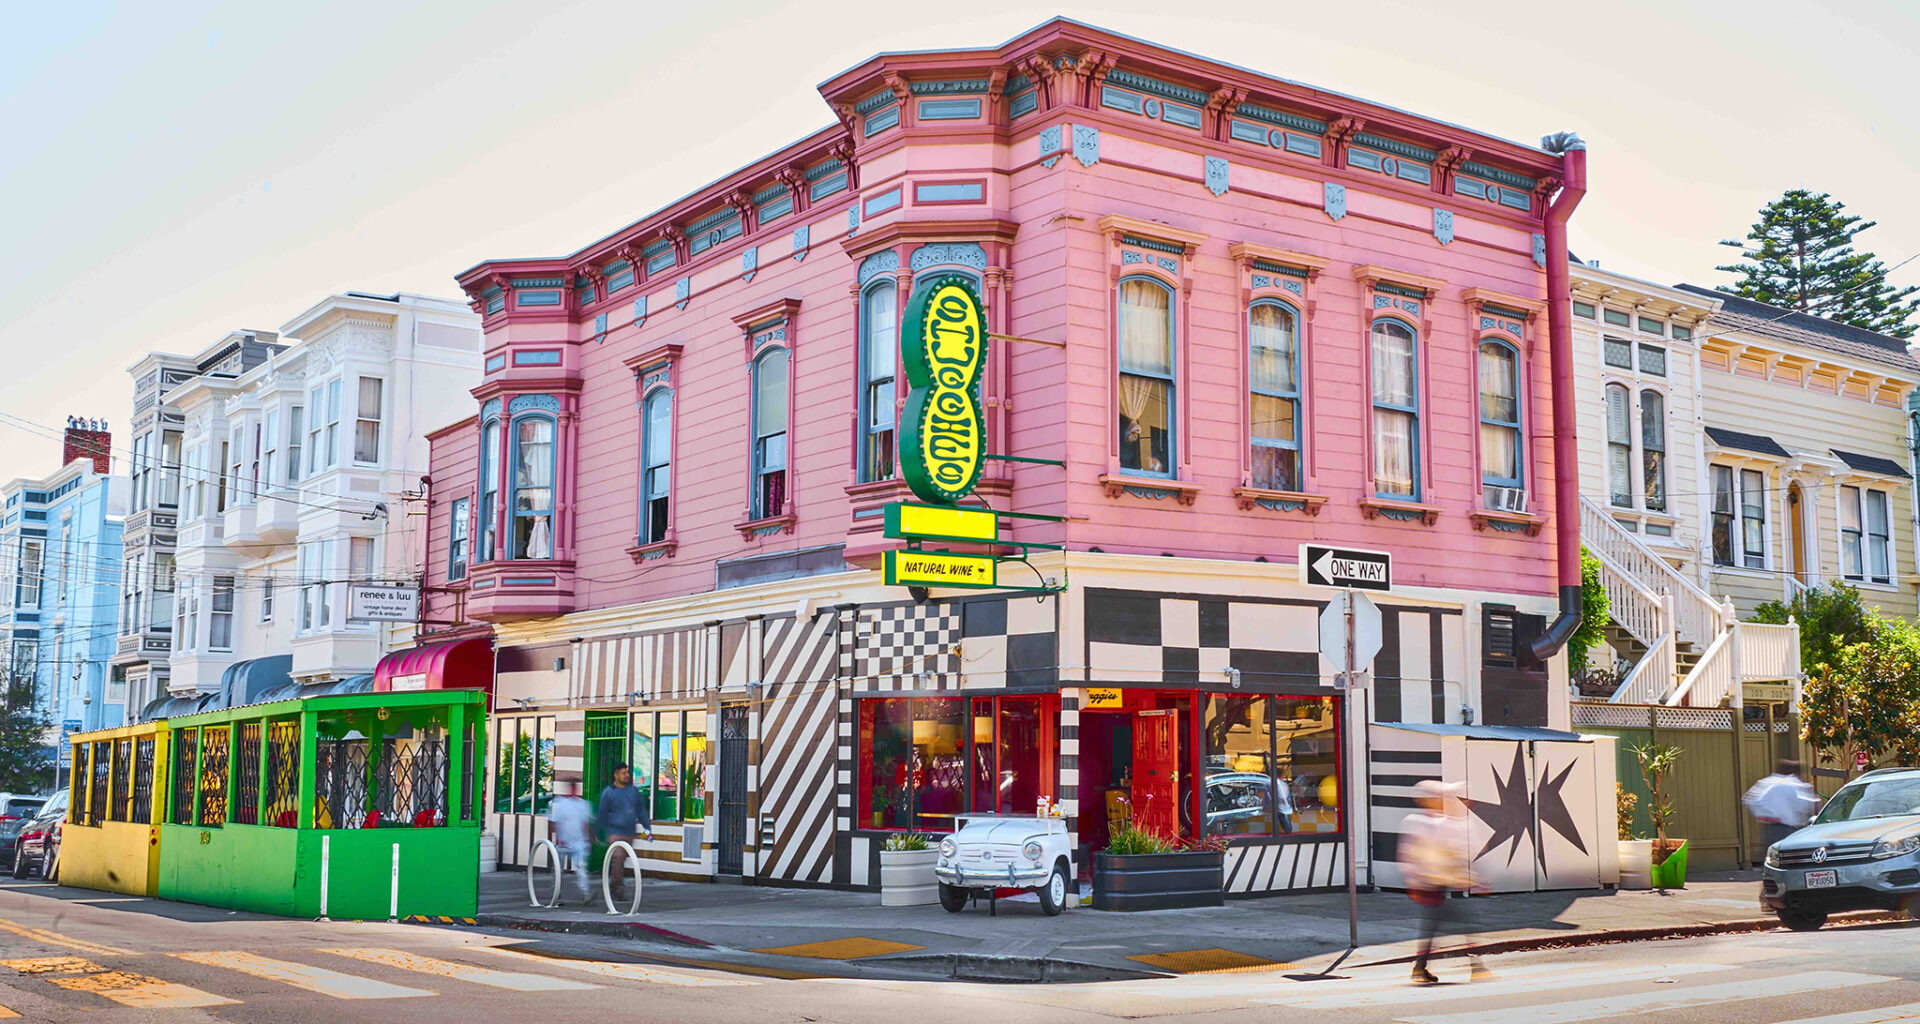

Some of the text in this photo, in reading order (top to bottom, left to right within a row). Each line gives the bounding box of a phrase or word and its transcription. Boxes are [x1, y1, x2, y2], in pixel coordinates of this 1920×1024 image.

[904, 561, 974, 576] NATURAL WINE
[1331, 560, 1383, 580] ONE WAY
[360, 591, 386, 599] renee
[396, 591, 411, 600] luu
[1089, 691, 1118, 704] uggies
